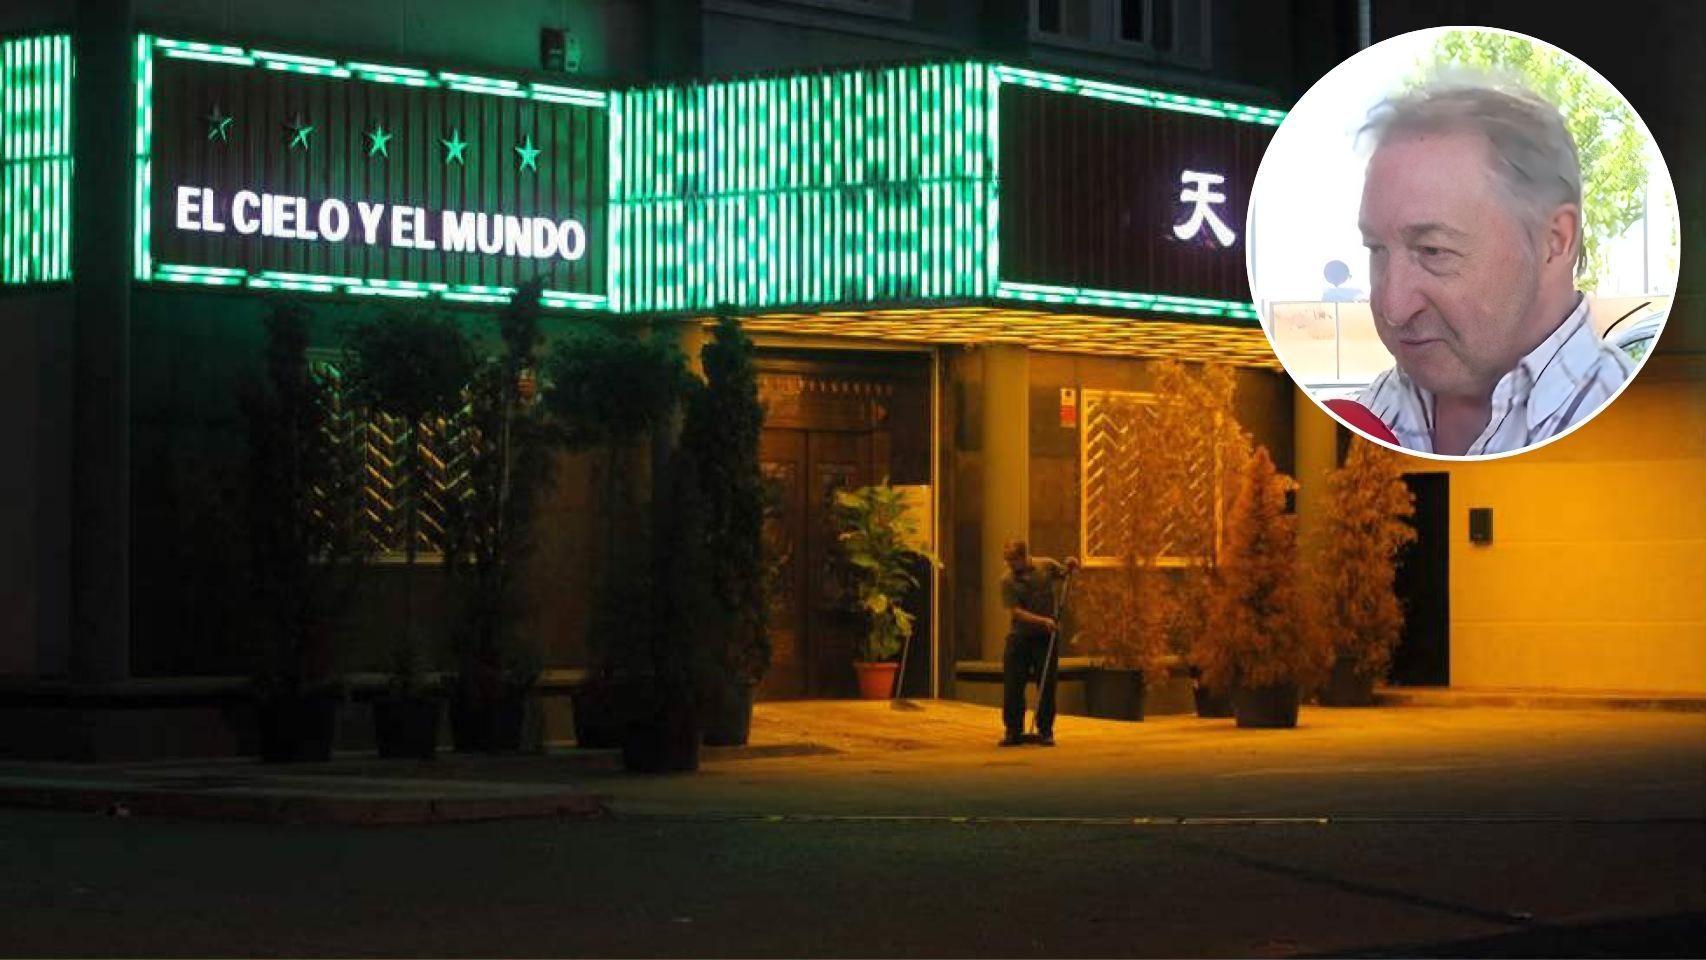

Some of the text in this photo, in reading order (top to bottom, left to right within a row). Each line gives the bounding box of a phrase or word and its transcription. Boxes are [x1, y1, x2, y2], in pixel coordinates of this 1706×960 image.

[177, 186, 586, 261] EL CIELO Y EL MUNDO
[1172, 170, 1236, 247] 天
